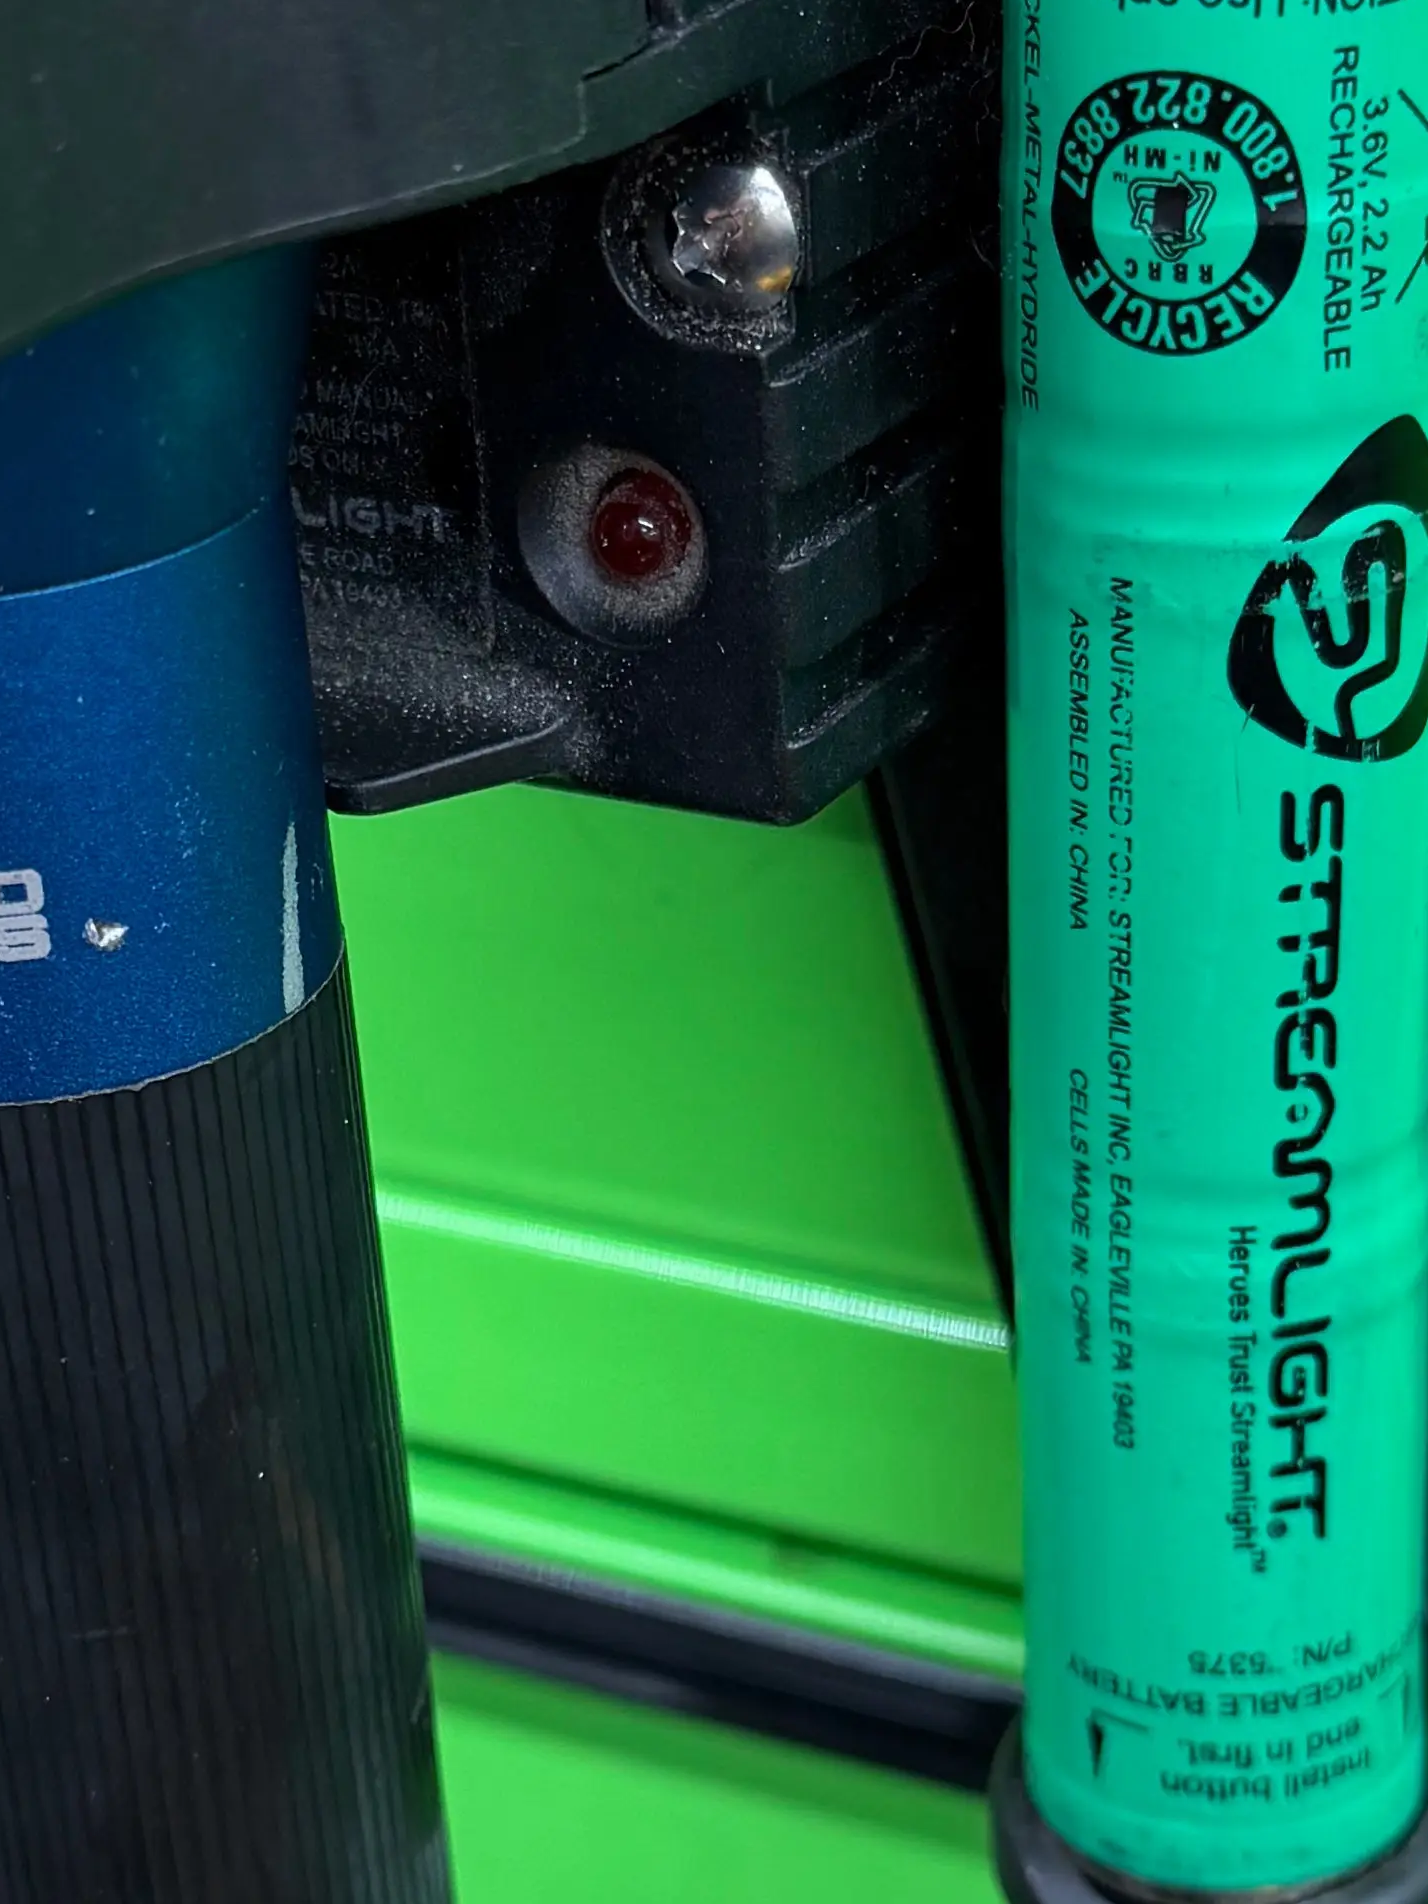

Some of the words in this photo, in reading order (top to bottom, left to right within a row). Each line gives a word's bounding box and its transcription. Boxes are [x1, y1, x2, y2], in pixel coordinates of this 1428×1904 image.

[1123, 146, 1221, 172] Ni-MH
[1359, 98, 1389, 189] 3.6V,
[1323, 45, 1360, 372] RECHARGEABLE
[1360, 197, 1390, 262] 2.2
[1074, 258, 1274, 351] RECYCLE
[1124, 259, 1214, 286] RBRC
[1358, 270, 1385, 310] Ah
[1068, 608, 1090, 793] ASSEMBLED
[1108, 576, 1134, 828] MANUFACTURED
[1070, 799, 1090, 837] IN:
[1069, 844, 1090, 931] CHINA
[1108, 908, 1133, 1110] STREAMLIGHT
[1069, 1068, 1088, 1159] CELLS
[1106, 1113, 1132, 1166] INC,
[1070, 1159, 1089, 1238] MADE
[1108, 1175, 1132, 1334] EAGLEVILLE
[1072, 1284, 1091, 1364] CHINA
[1110, 1339, 1134, 1378] PA
[1229, 1330, 1257, 1396] Trust
[1112, 1380, 1135, 1450] 19403
[1066, 1652, 1207, 1716] BATTERY
[1177, 1735, 1255, 1769] first.
[1265, 1734, 1294, 1760] in
[1307, 1716, 1362, 1755] end
[1160, 1770, 1269, 1803] button
[1283, 1749, 1372, 1798] Install
